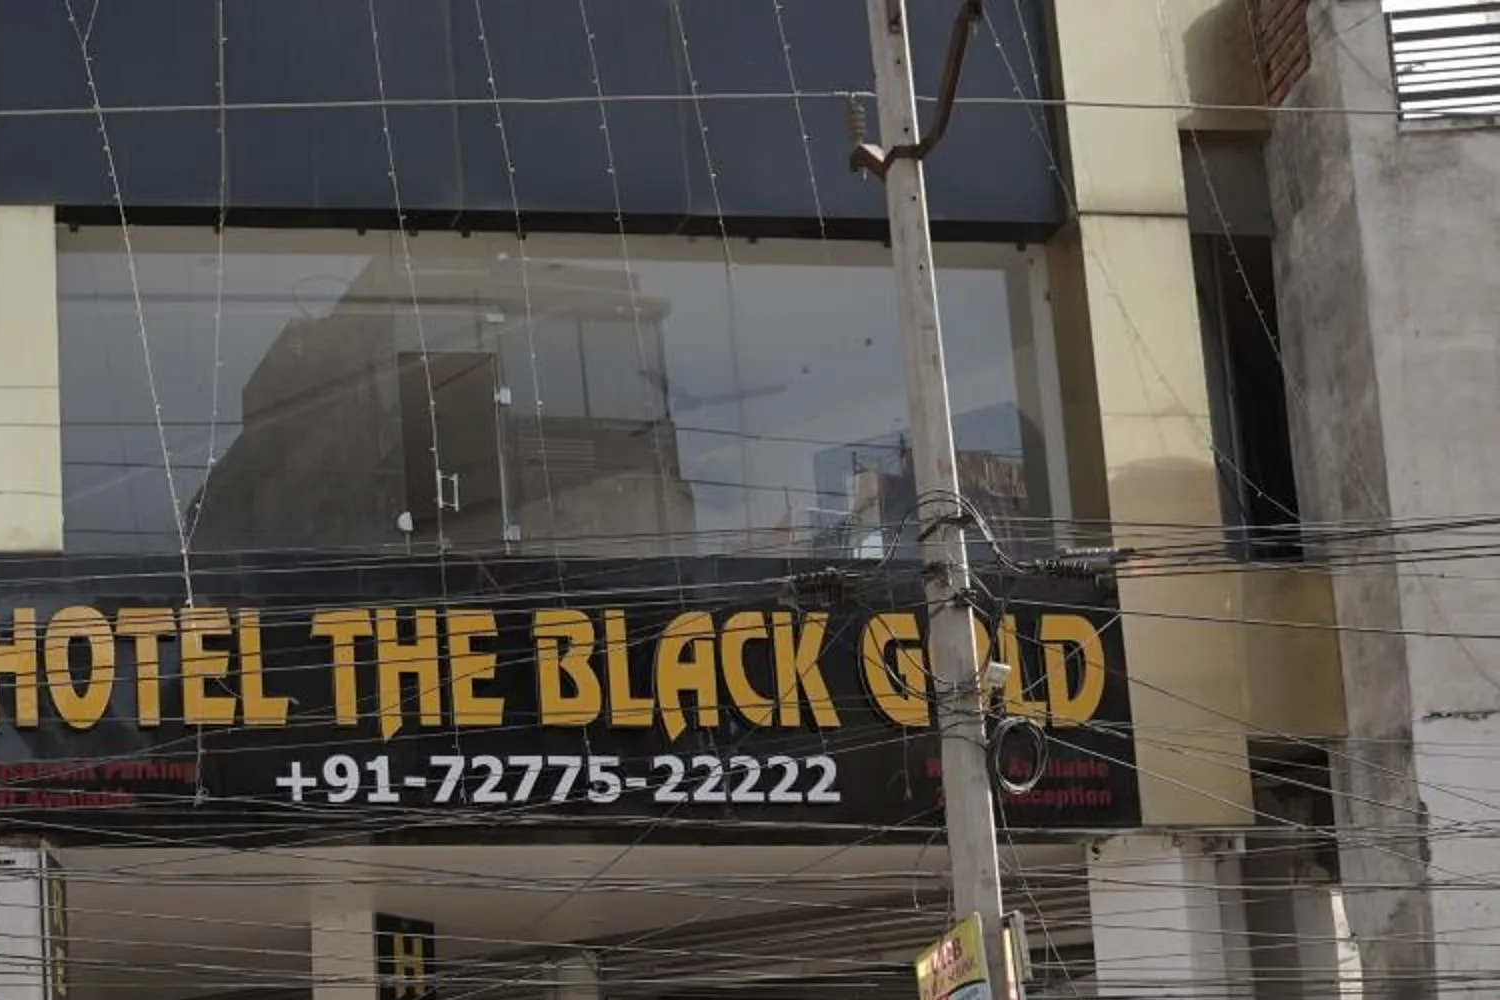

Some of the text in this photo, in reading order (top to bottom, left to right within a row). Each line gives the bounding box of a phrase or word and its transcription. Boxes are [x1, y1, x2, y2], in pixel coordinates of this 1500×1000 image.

[310, 608, 504, 743] THE
[532, 607, 841, 742] BLACK
[863, 612, 1105, 728] GLD
[276, 754, 841, 805] +91-72775-22222
